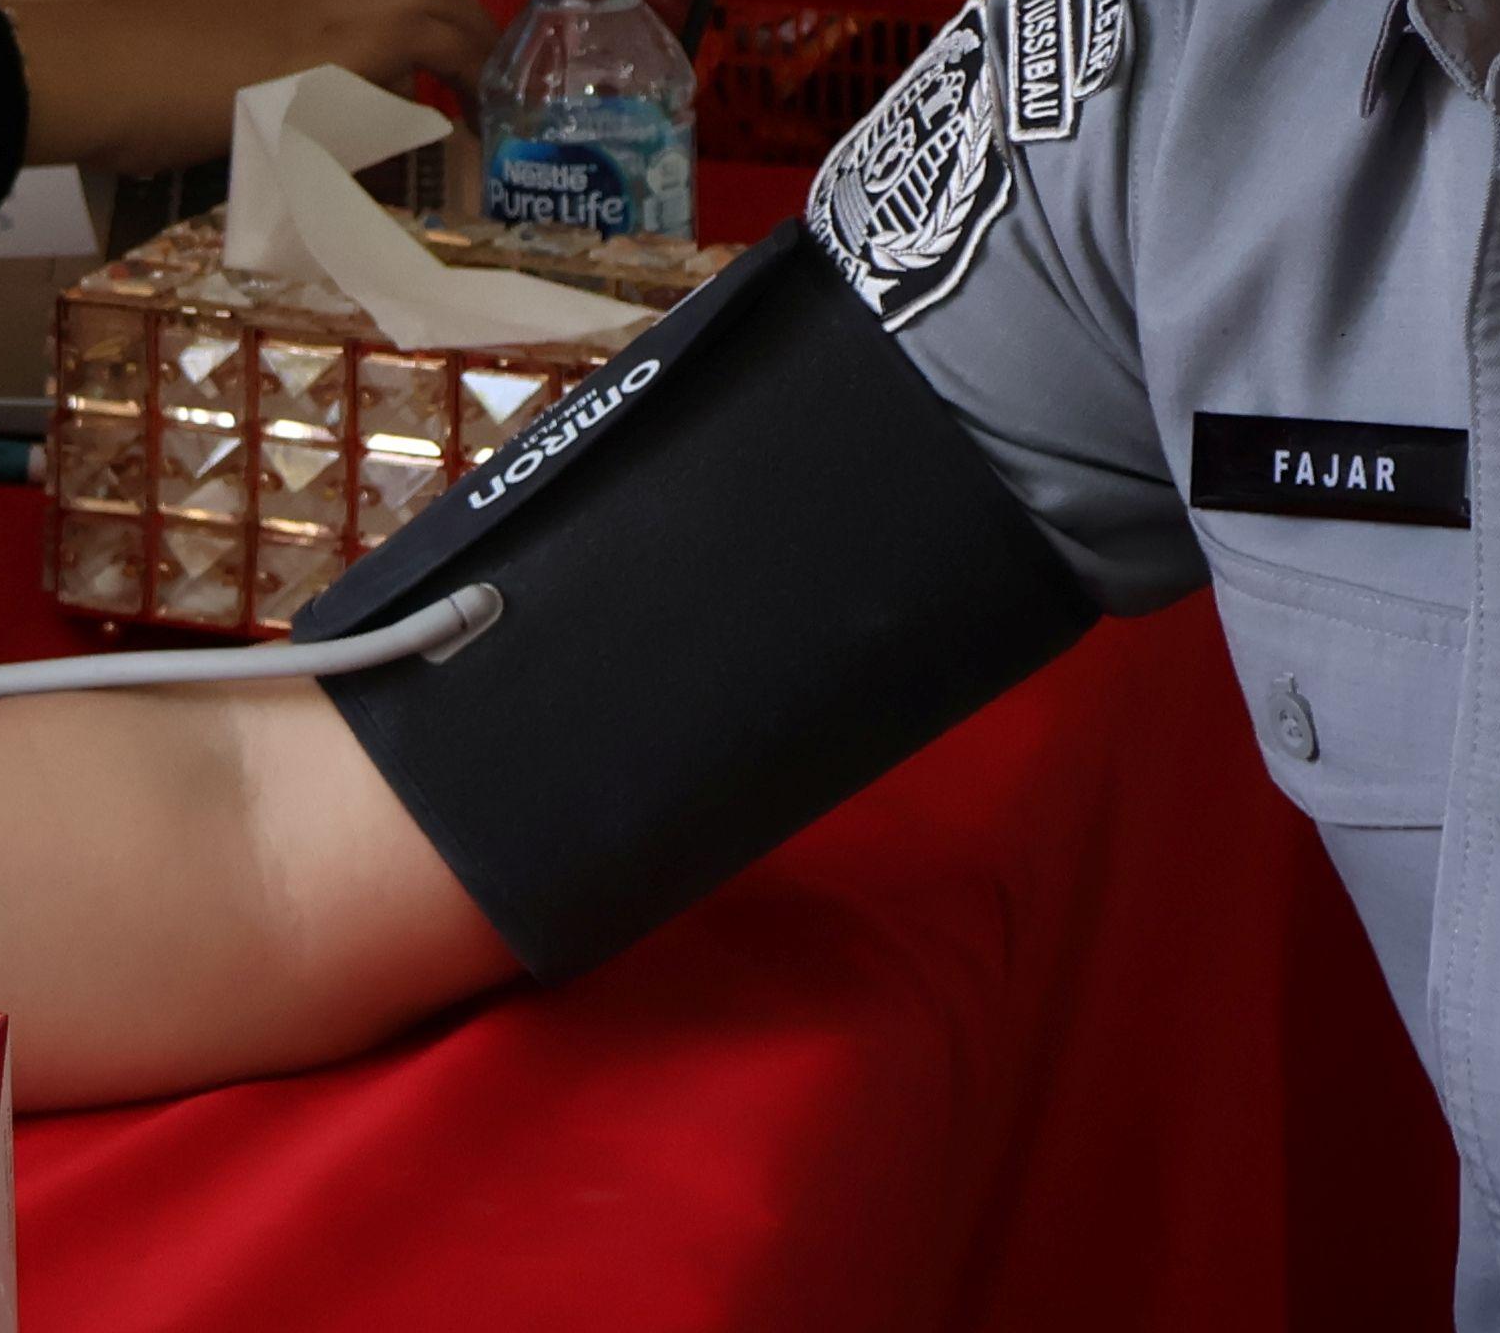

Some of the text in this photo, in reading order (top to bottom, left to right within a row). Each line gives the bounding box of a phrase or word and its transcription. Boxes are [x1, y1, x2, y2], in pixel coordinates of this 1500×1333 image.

[488, 179, 625, 230] Pure Life
[1271, 448, 1397, 494] FAJAR
